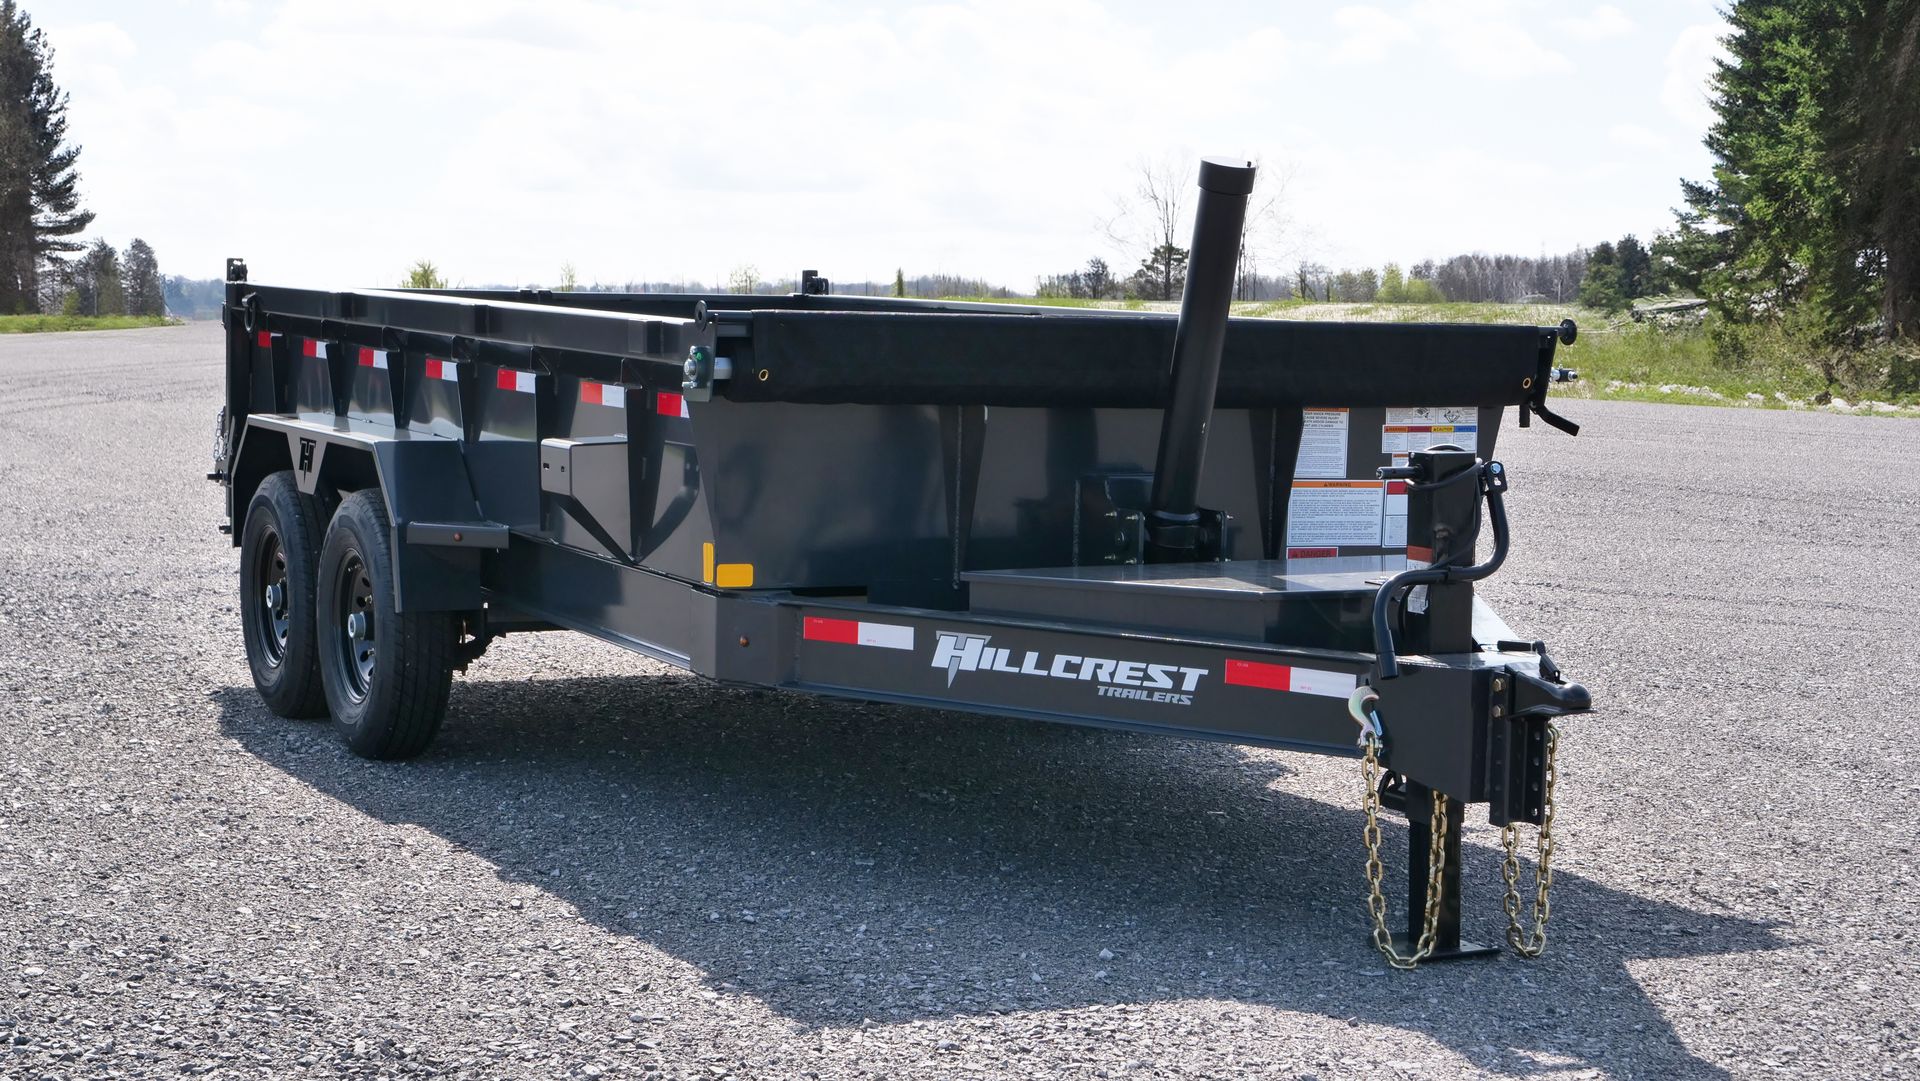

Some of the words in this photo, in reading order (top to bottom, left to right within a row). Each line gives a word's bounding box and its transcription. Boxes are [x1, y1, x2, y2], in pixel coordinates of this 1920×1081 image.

[1300, 549, 1331, 557] DANGER
[931, 630, 1209, 691] HILLCREST
[1096, 685, 1194, 705] TRAILERS
